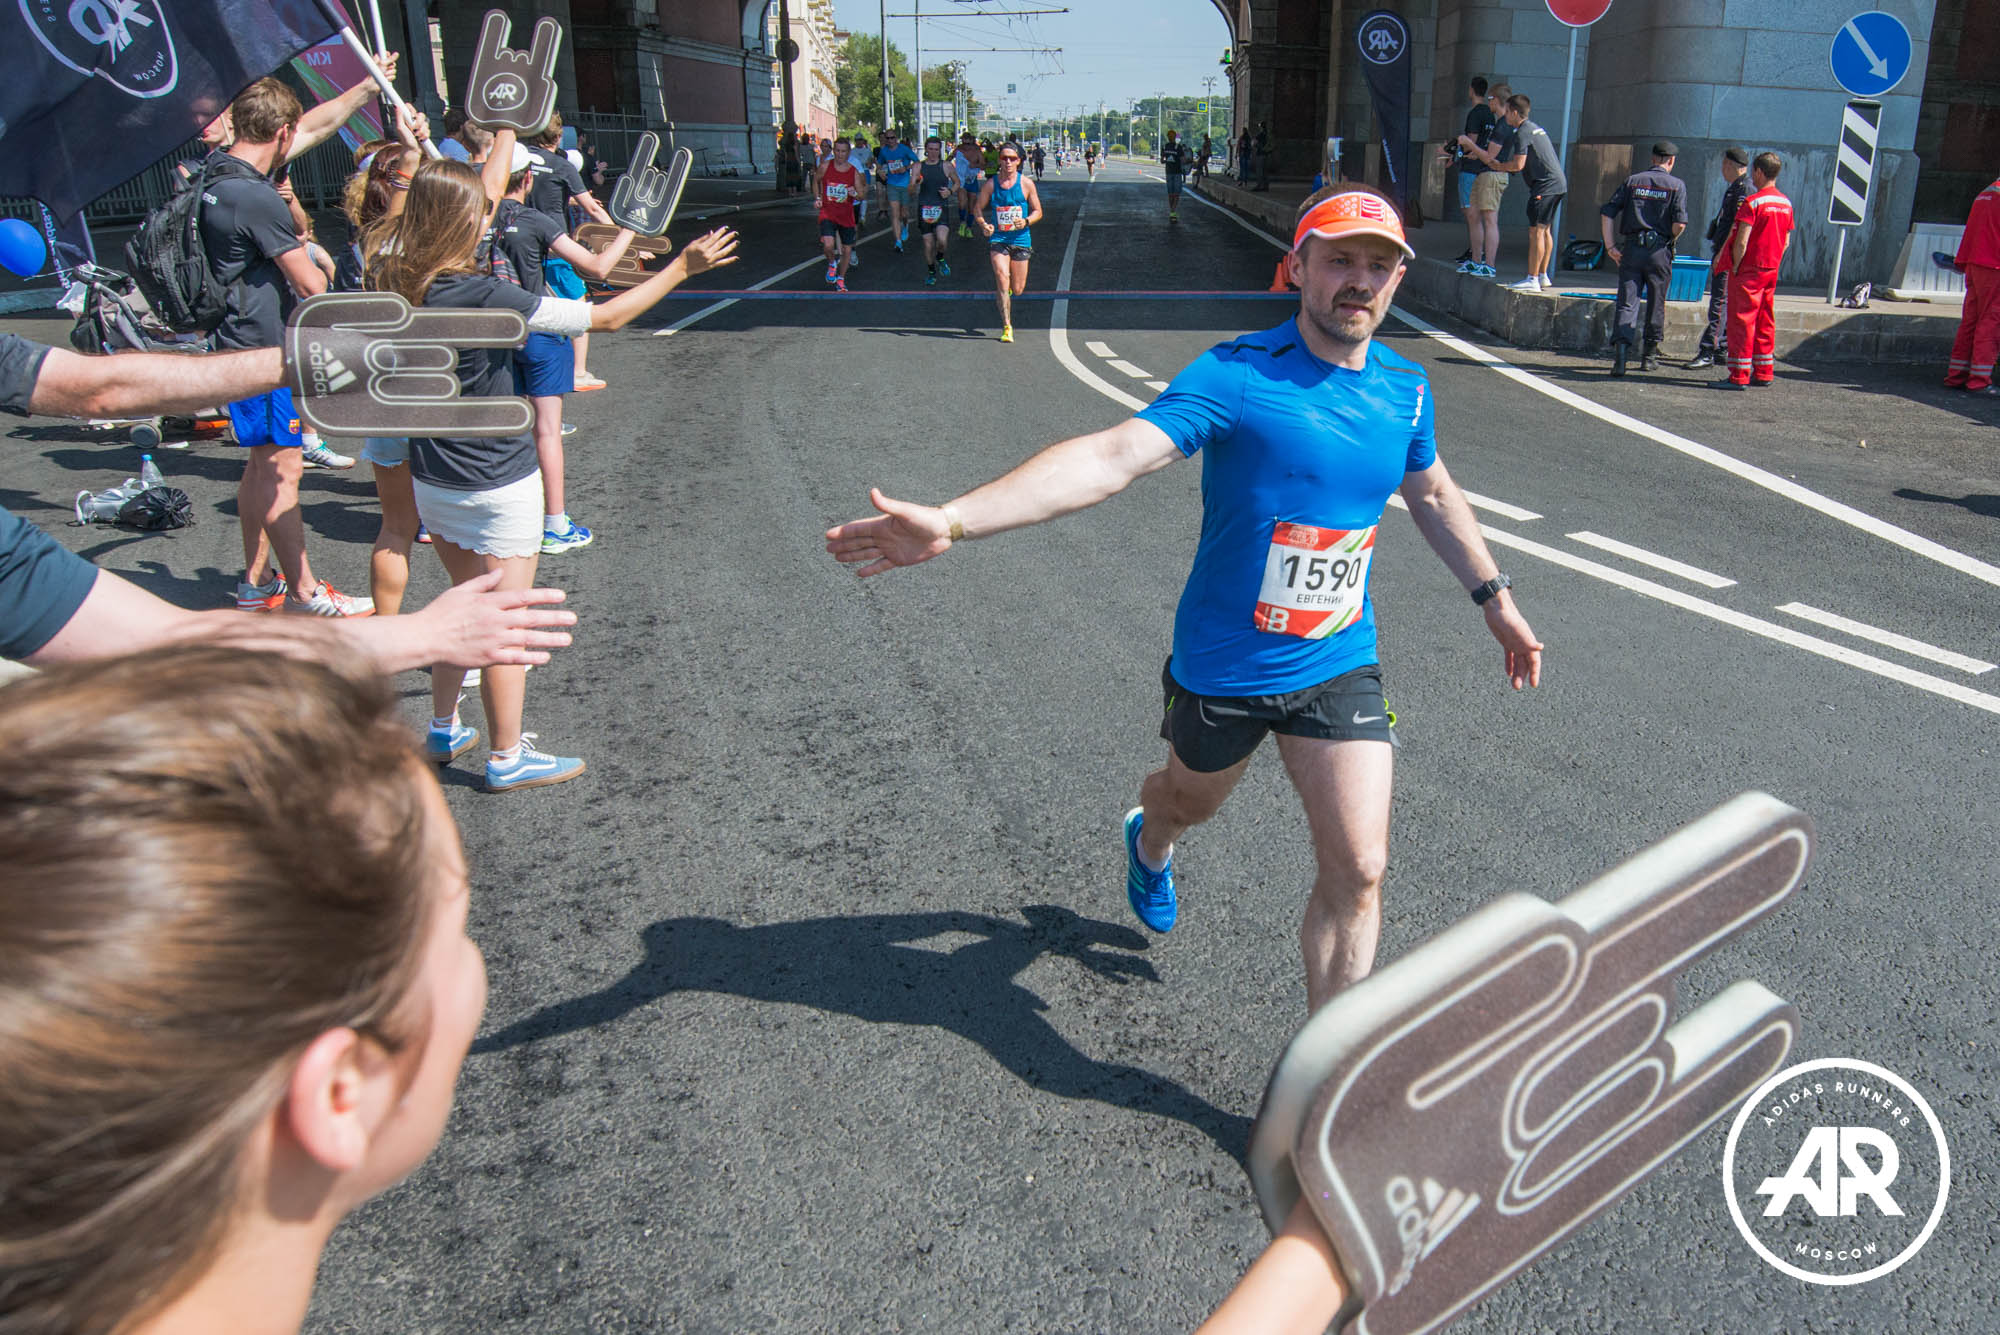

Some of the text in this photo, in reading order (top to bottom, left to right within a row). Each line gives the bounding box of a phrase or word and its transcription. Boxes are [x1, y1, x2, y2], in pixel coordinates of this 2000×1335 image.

[489, 83, 517, 100] AR
[309, 342, 328, 398] adidas
[1284, 554, 1362, 591] 1590
